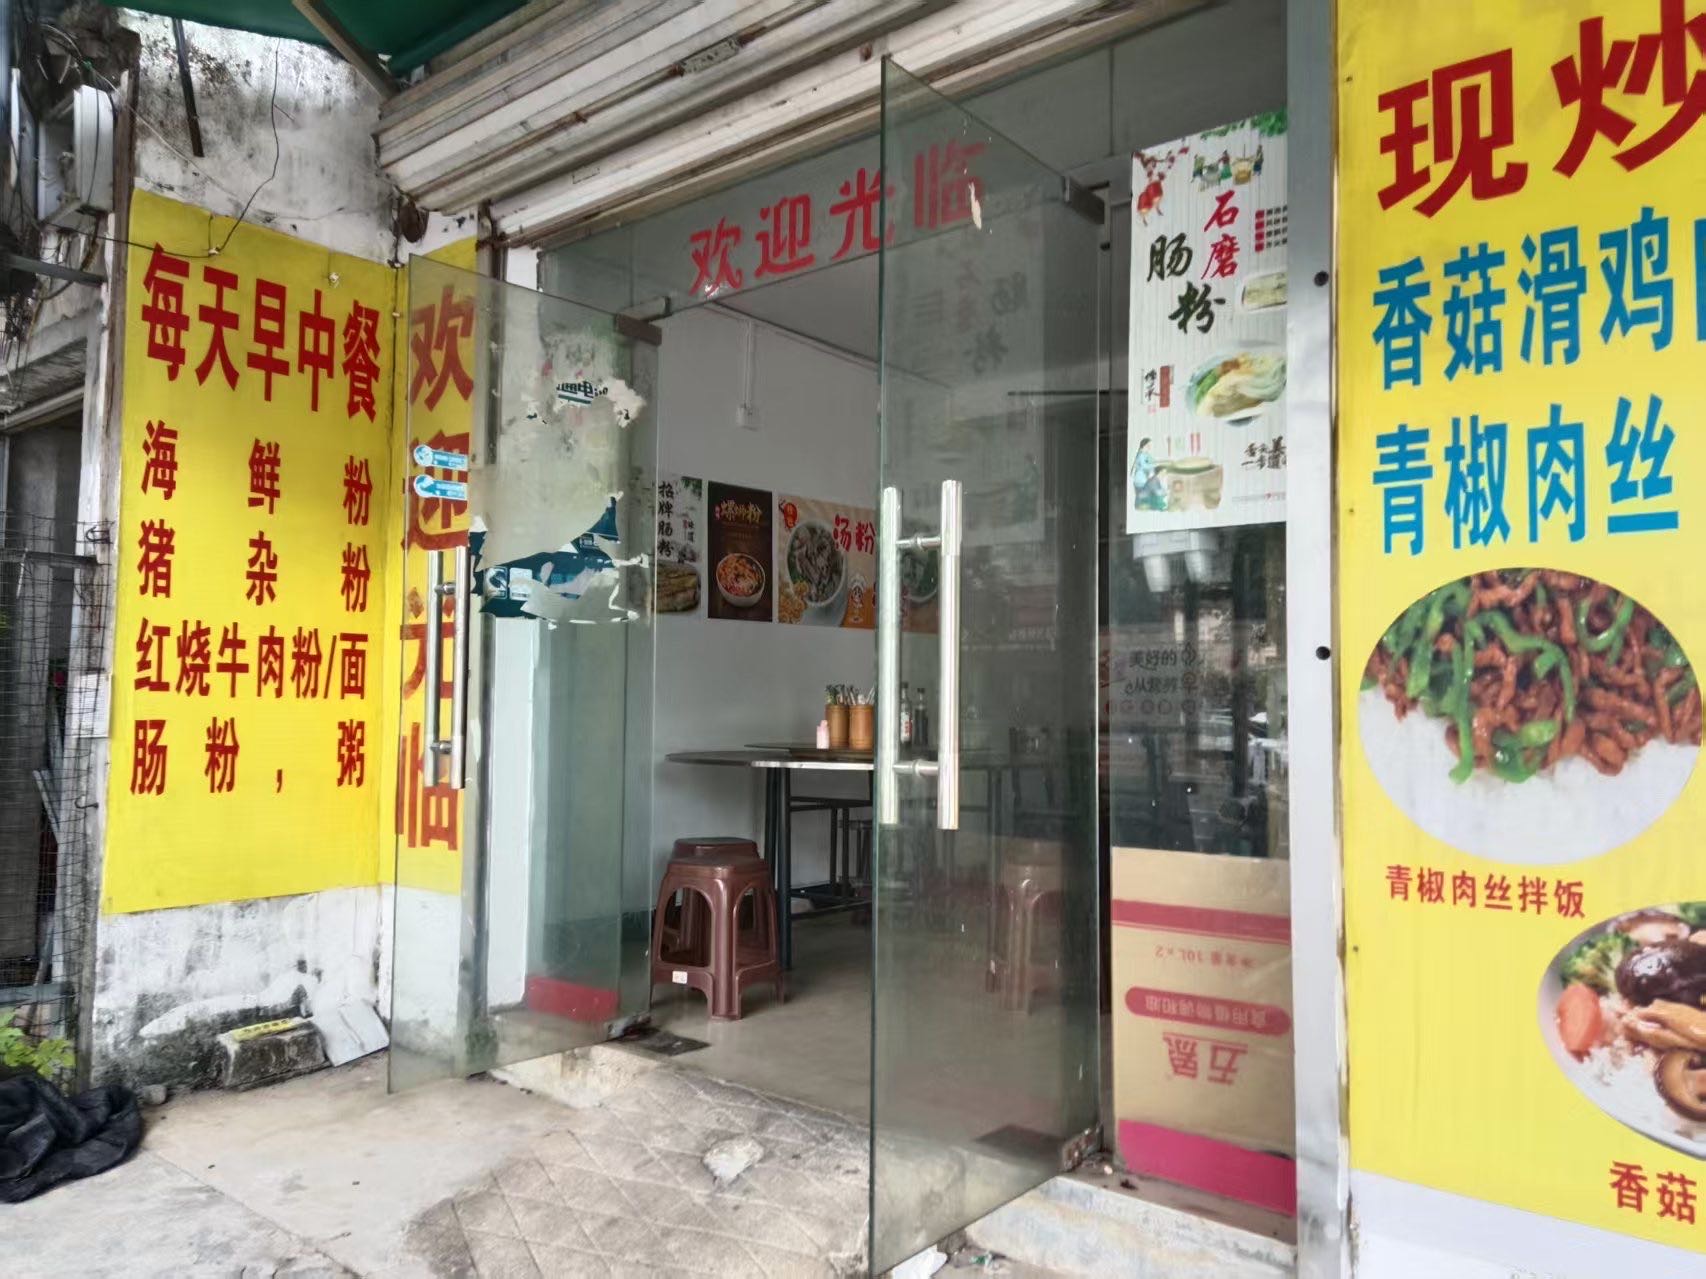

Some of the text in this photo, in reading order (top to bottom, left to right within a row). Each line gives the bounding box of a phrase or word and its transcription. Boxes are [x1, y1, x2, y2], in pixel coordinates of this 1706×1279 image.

[1377, 0, 1706, 218] 现炒
[689, 138, 987, 297] 欢迎光临
[1201, 190, 1240, 280] 石磨
[141, 242, 381, 424] 每天早中餐
[1147, 233, 1226, 335] 肠粉
[1372, 206, 1706, 391] 香菇滑鸡
[141, 420, 373, 526] 海鲜粉
[658, 481, 674, 558] 招牌肠粉
[1372, 393, 1680, 556] 青椒肉丝
[137, 518, 371, 613] 猪杂粉
[832, 514, 876, 555] 汤粉
[134, 617, 369, 700] 红烧牛肉粉/面
[1386, 864, 1586, 918] 青椒肉丝拌饭
[1609, 1161, 1697, 1225] 香菇
